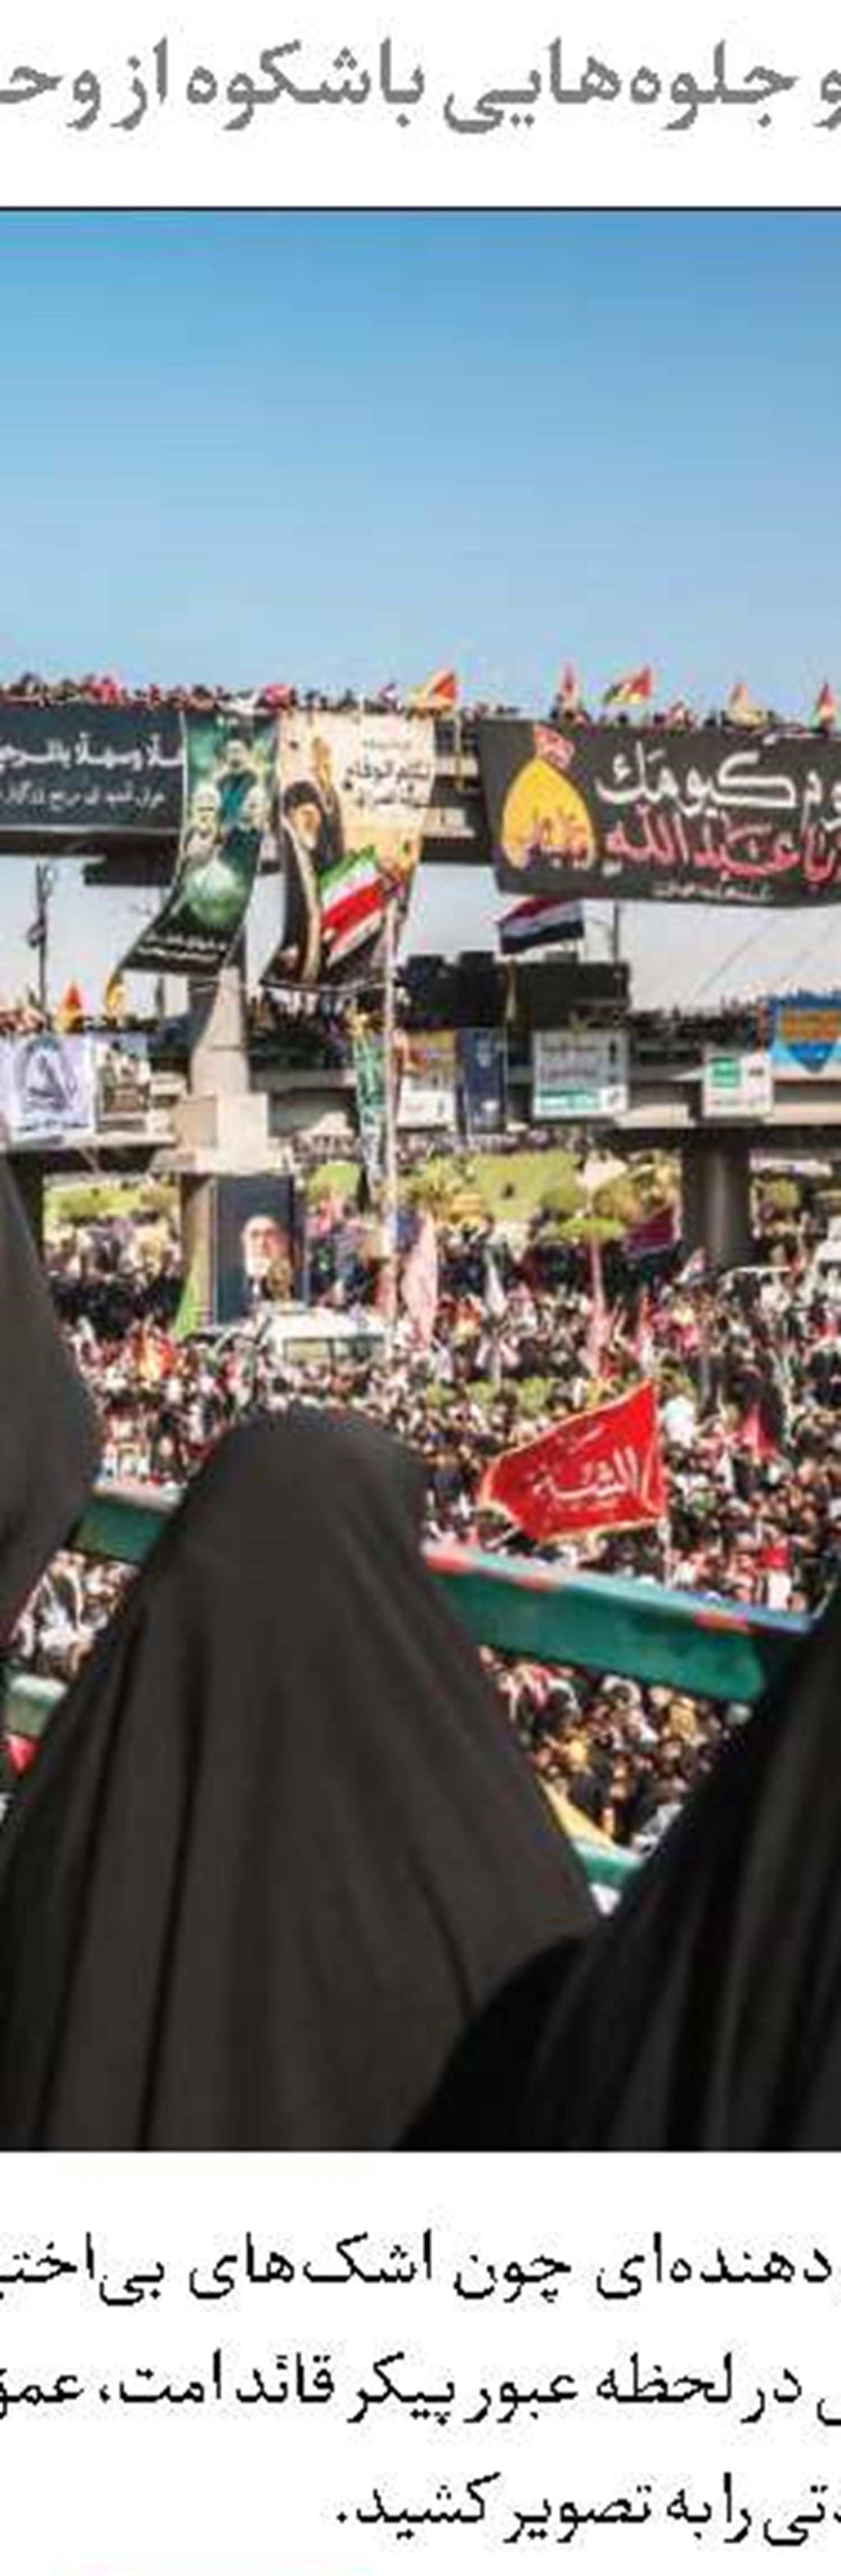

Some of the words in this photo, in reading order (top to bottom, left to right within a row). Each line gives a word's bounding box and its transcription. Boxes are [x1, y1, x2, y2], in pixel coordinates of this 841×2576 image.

[0, 66, 101, 131] وح
[112, 38, 168, 131] از
[187, 38, 425, 131] باشکوه
[190, 2228, 432, 2300] اشک‌های
[453, 2255, 572, 2303] چون
[236, 2352, 335, 2403] قائد
[347, 2352, 455, 2426] پیکر
[464, 2375, 578, 2424] عبور
[597, 2352, 732, 2403] لحظه
[741, 2369, 802, 2424] در
[337, 2472, 501, 2540] کشید.
[503, 2485, 652, 2543] تصویر
[667, 2489, 712, 2540] به
[724, 2472, 752, 2543] را
